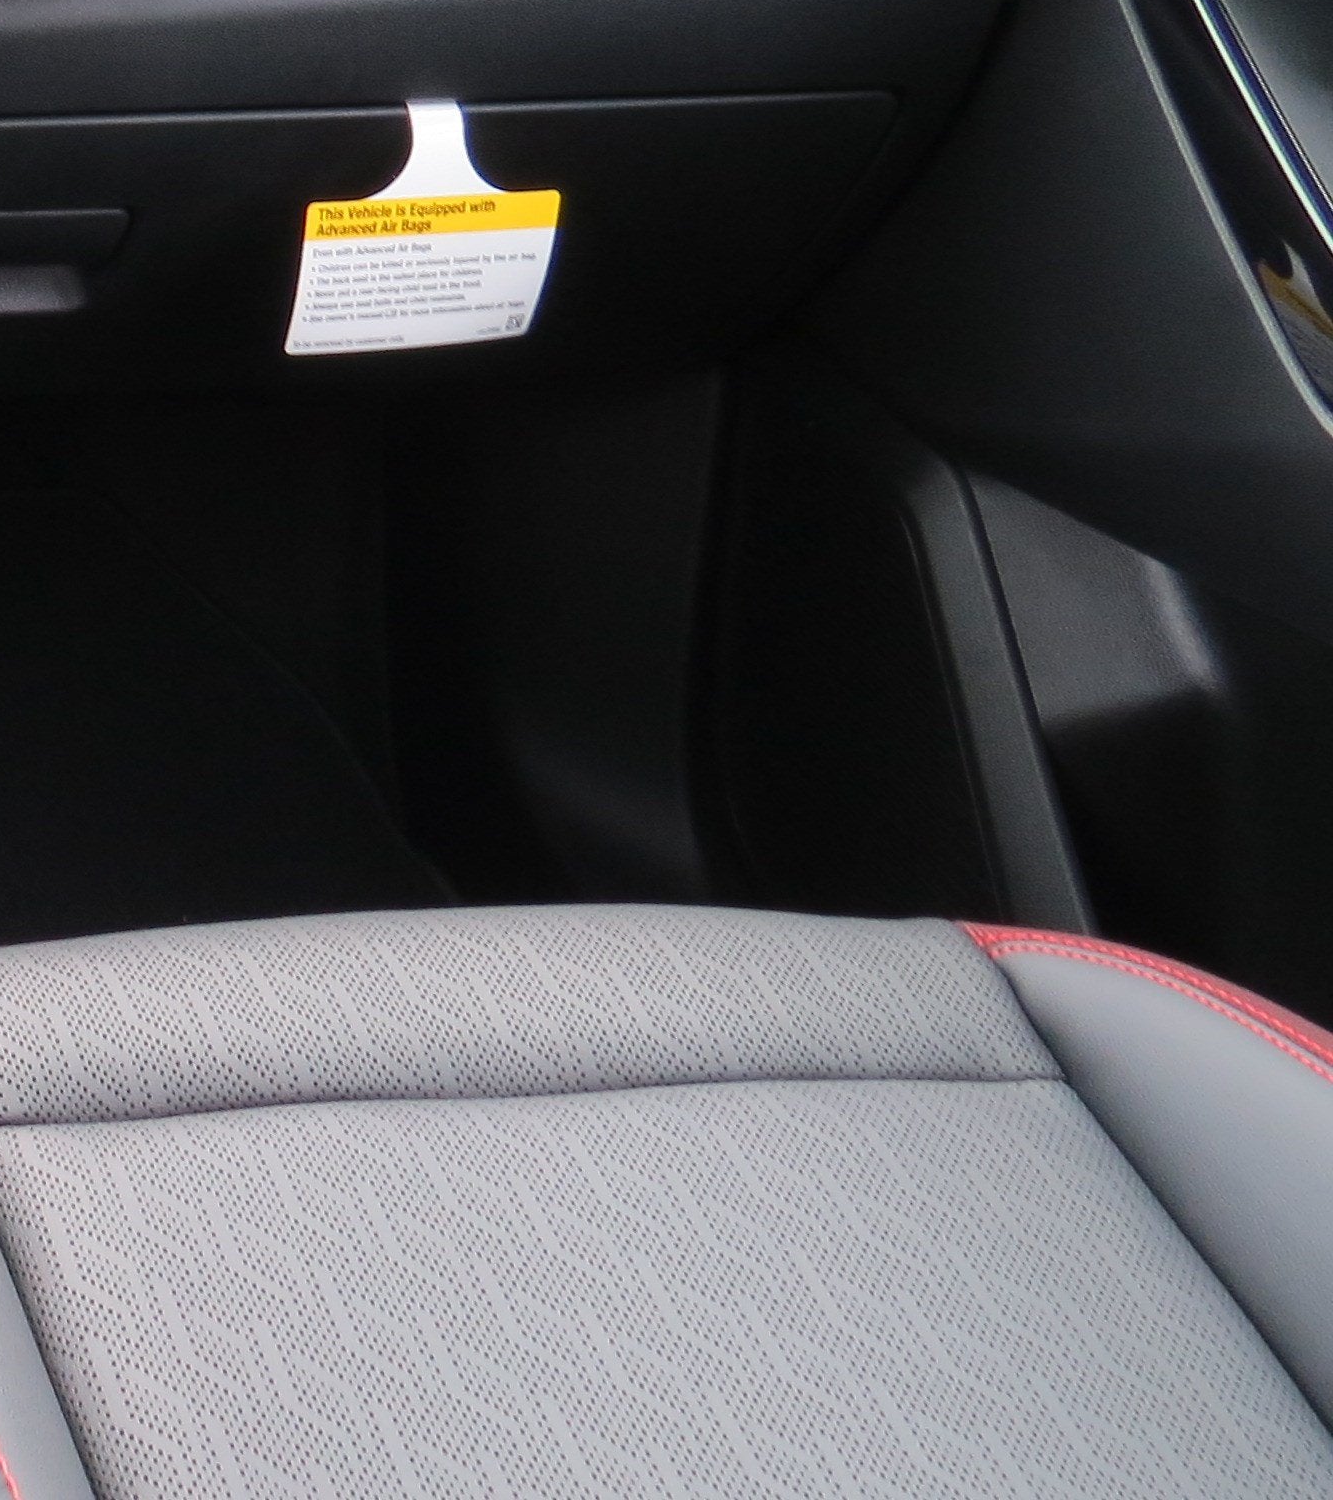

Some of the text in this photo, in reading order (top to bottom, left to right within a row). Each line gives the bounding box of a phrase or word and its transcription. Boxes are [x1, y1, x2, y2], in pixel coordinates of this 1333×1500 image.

[318, 205, 343, 222] This
[347, 204, 393, 221] Vehicle
[409, 200, 467, 219] Equipped
[469, 199, 496, 214] with
[316, 218, 432, 238] Advanced Air Bags
